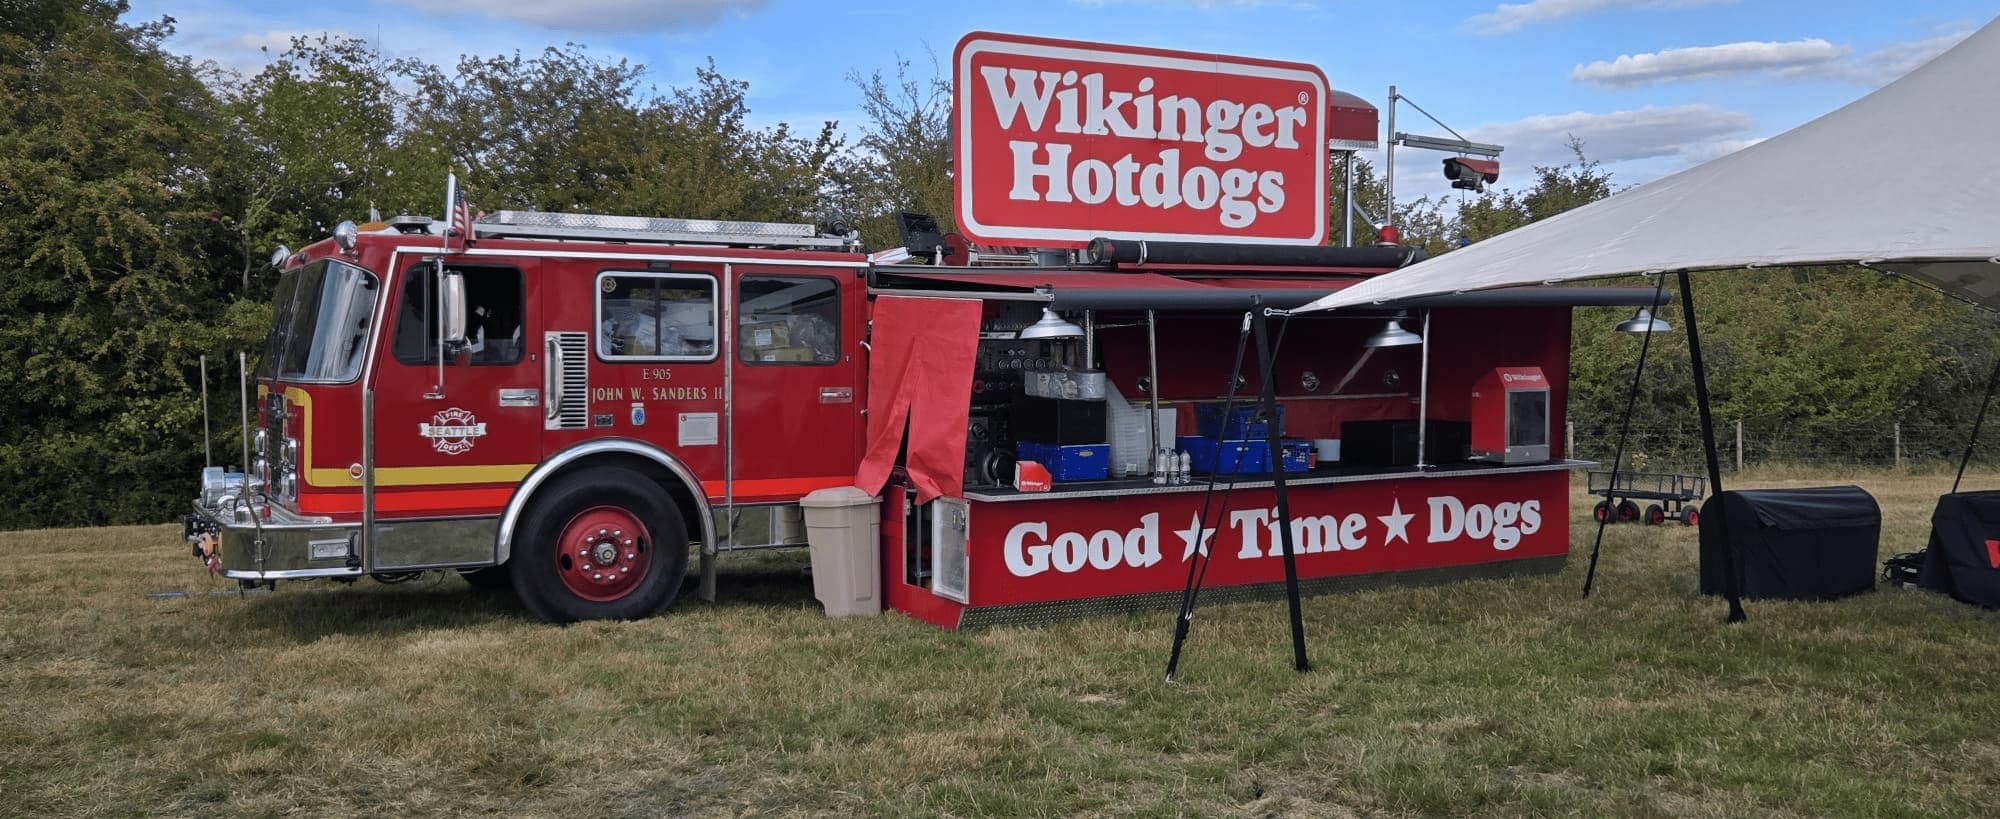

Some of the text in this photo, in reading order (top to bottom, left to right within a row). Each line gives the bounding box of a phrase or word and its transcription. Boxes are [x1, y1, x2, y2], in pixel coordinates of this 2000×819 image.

[1008, 140, 1285, 228] Hotdogs
[643, 368, 671, 380] E 905
[592, 387, 722, 404] JOHN W. SANDERS II
[445, 411, 465, 419] FIRE
[428, 426, 481, 436] SEATTLE
[1003, 495, 1542, 577] Good Time Dogs
